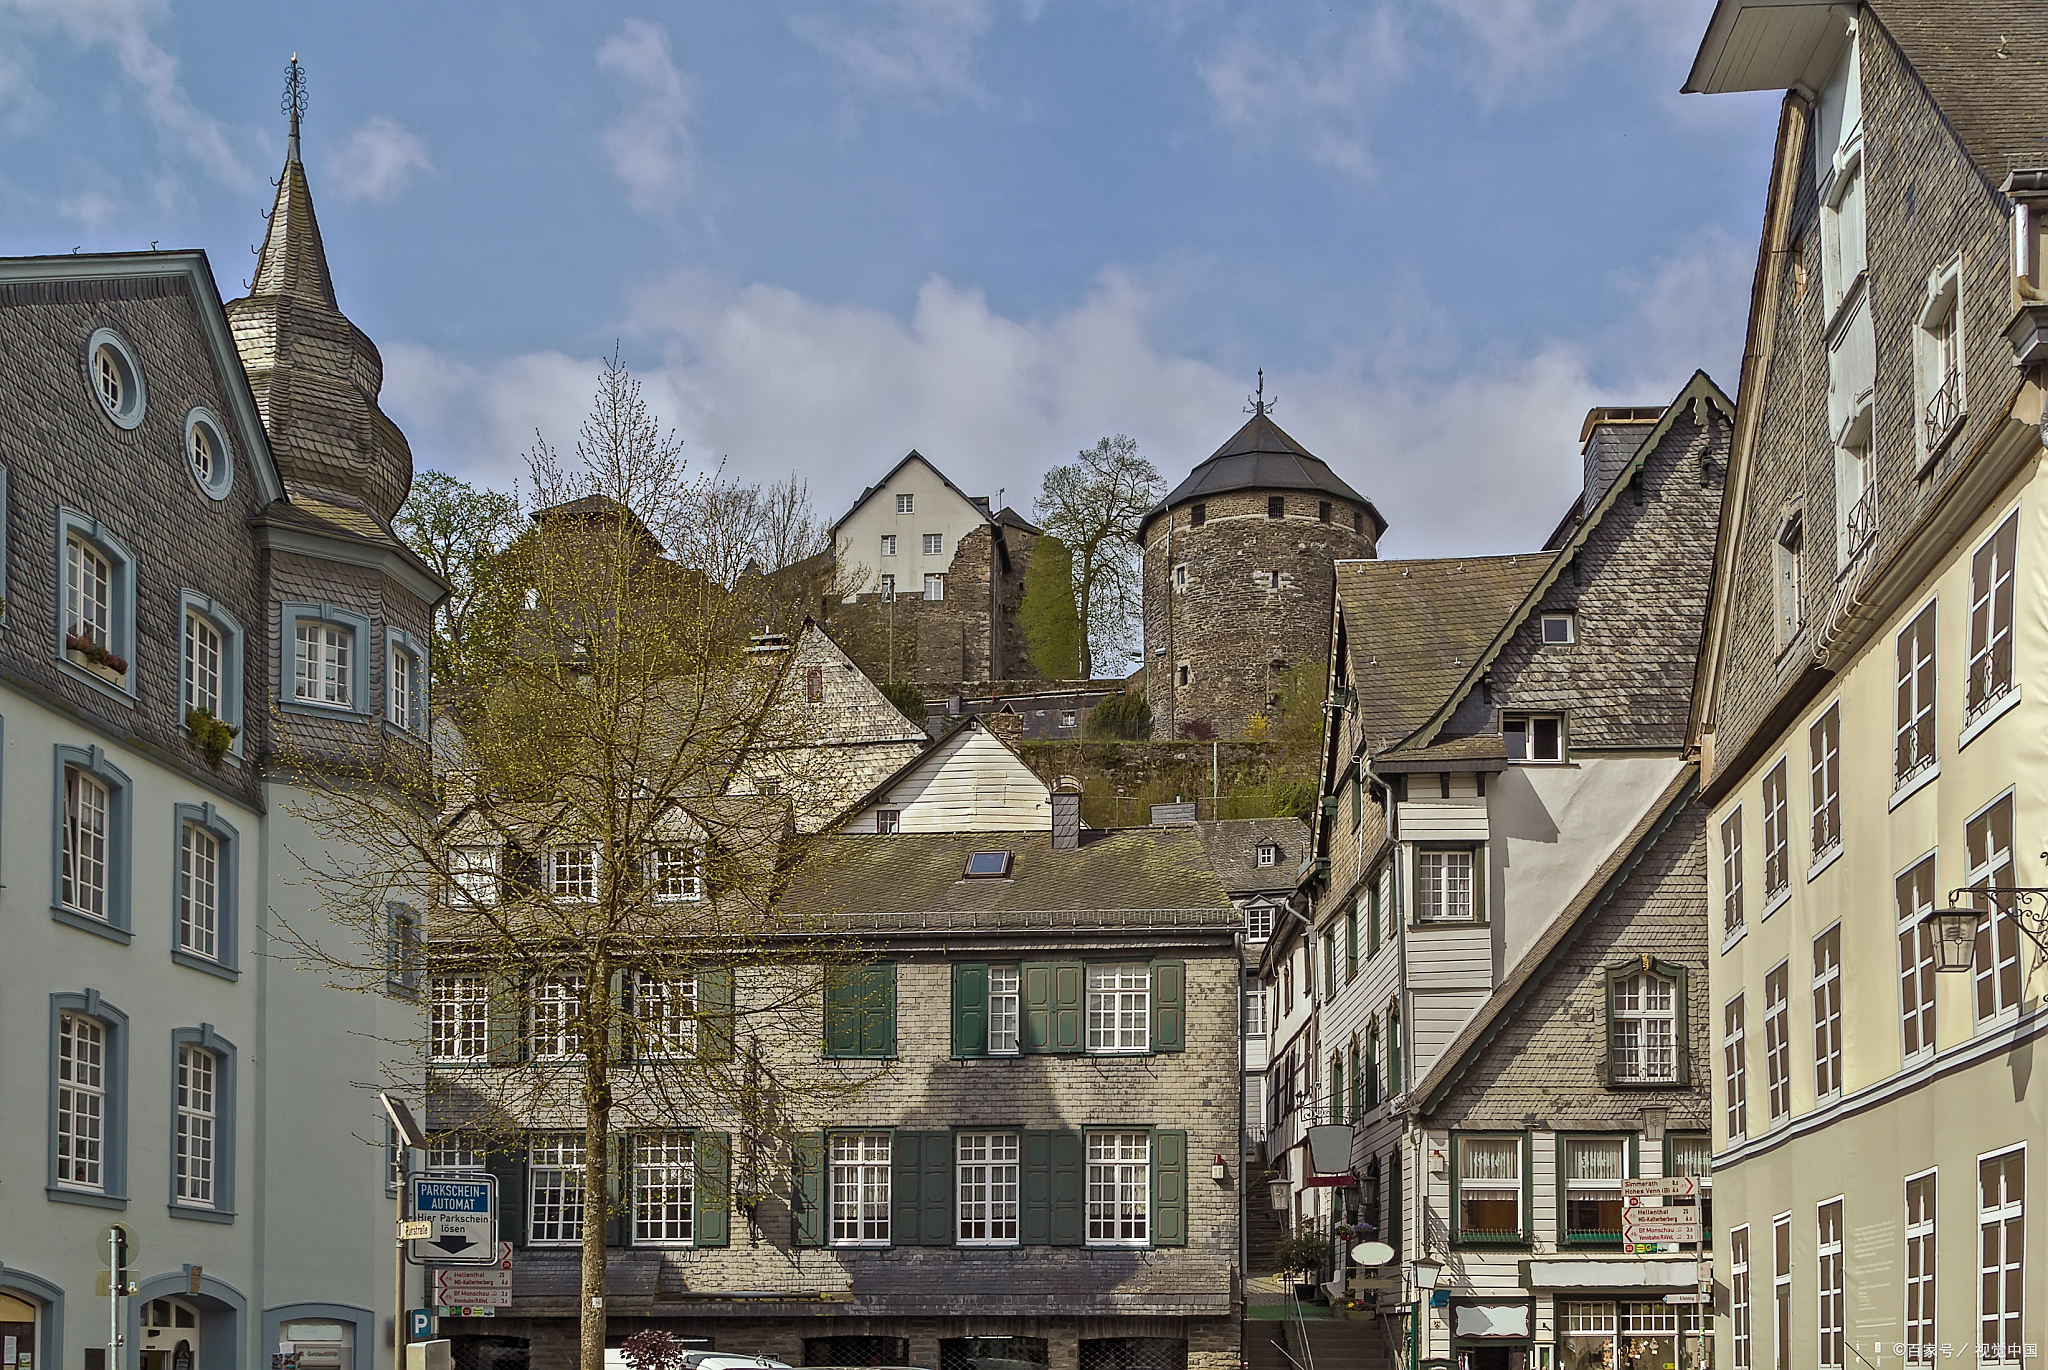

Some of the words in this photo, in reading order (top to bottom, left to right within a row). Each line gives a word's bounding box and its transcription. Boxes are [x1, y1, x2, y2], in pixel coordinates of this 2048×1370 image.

[421, 1184, 486, 1198] PARKSCHEIN-
[431, 1198, 475, 1211] AUTOMAT
[417, 1213, 436, 1222] Hier
[440, 1214, 489, 1223] Parkschein
[441, 1224, 465, 1233] lösen
[414, 1314, 428, 1334] P
